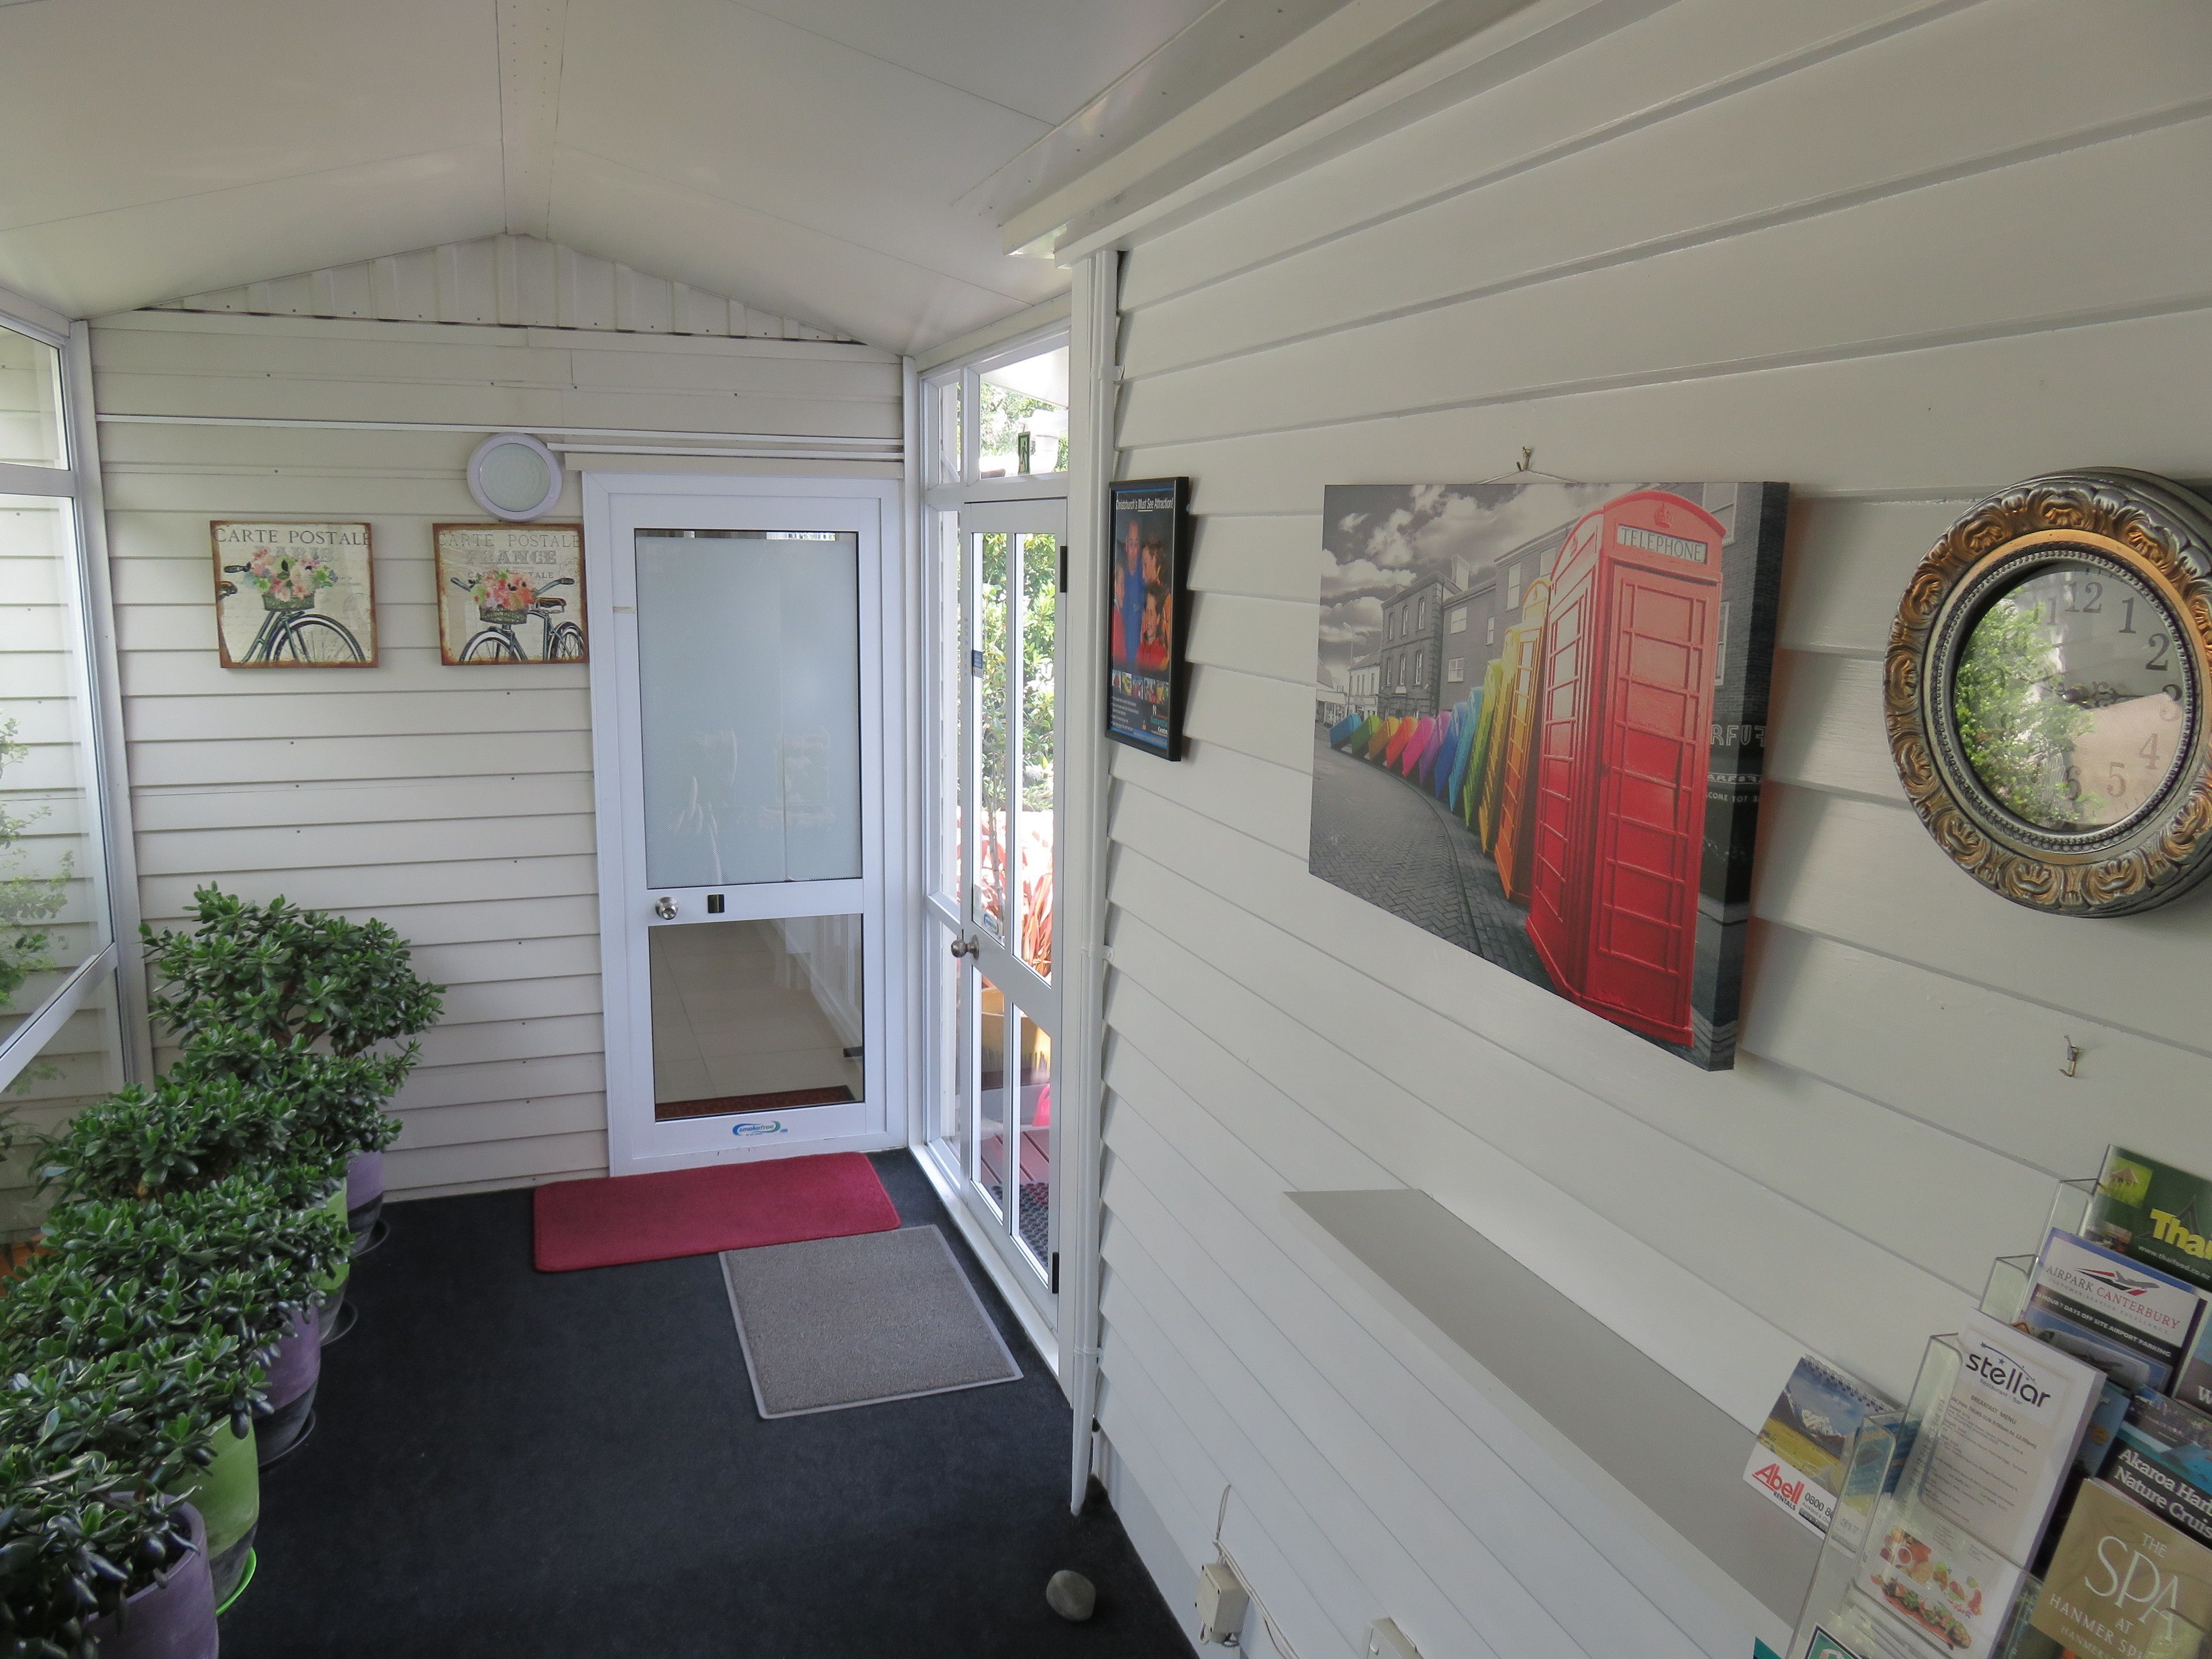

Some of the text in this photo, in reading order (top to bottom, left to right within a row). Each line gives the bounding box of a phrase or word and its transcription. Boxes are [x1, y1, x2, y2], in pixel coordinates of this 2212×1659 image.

[1138, 498, 1147, 509] Must
[1154, 497, 1173, 509] Attraction!
[213, 528, 370, 546] CARTE POSTALE
[438, 533, 580, 548] CARTE POSTALE
[1622, 528, 1701, 562] TELEPHONE
[2065, 582, 2103, 613] 12
[2118, 597, 2137, 634] 1
[2145, 633, 2170, 671] 2
[2139, 733, 2160, 770] 4
[2107, 762, 2127, 797] 5
[739, 1124, 774, 1132] smokefree
[2046, 1266, 2180, 1329] AIRPARK CANTERBURY
[2064, 1305, 2081, 1316] DAYS
[2081, 1313, 2094, 1322] OFF
[2093, 1318, 2109, 1329] SITE
[2108, 1325, 2139, 1341] AIRPORT
[2138, 1338, 2171, 1357] PARKING
[1965, 1352, 2051, 1408] stellar
[1979, 1378, 2023, 1405] Restaurant Bar
[1970, 1395, 2017, 1425] BREAKFAST MENU
[1752, 1463, 1805, 1505] Abell
[2113, 1465, 2168, 1509] Nature
[2118, 1449, 2176, 1493] Akaroa
[1773, 1491, 1796, 1511] RENTALS
[1805, 1493, 1825, 1512] 0800
[2142, 1532, 2167, 1558] THE
[2085, 1535, 2179, 1642] SPA
[2050, 1593, 2114, 1645] HANMER
[2115, 1618, 2134, 1634] AT
